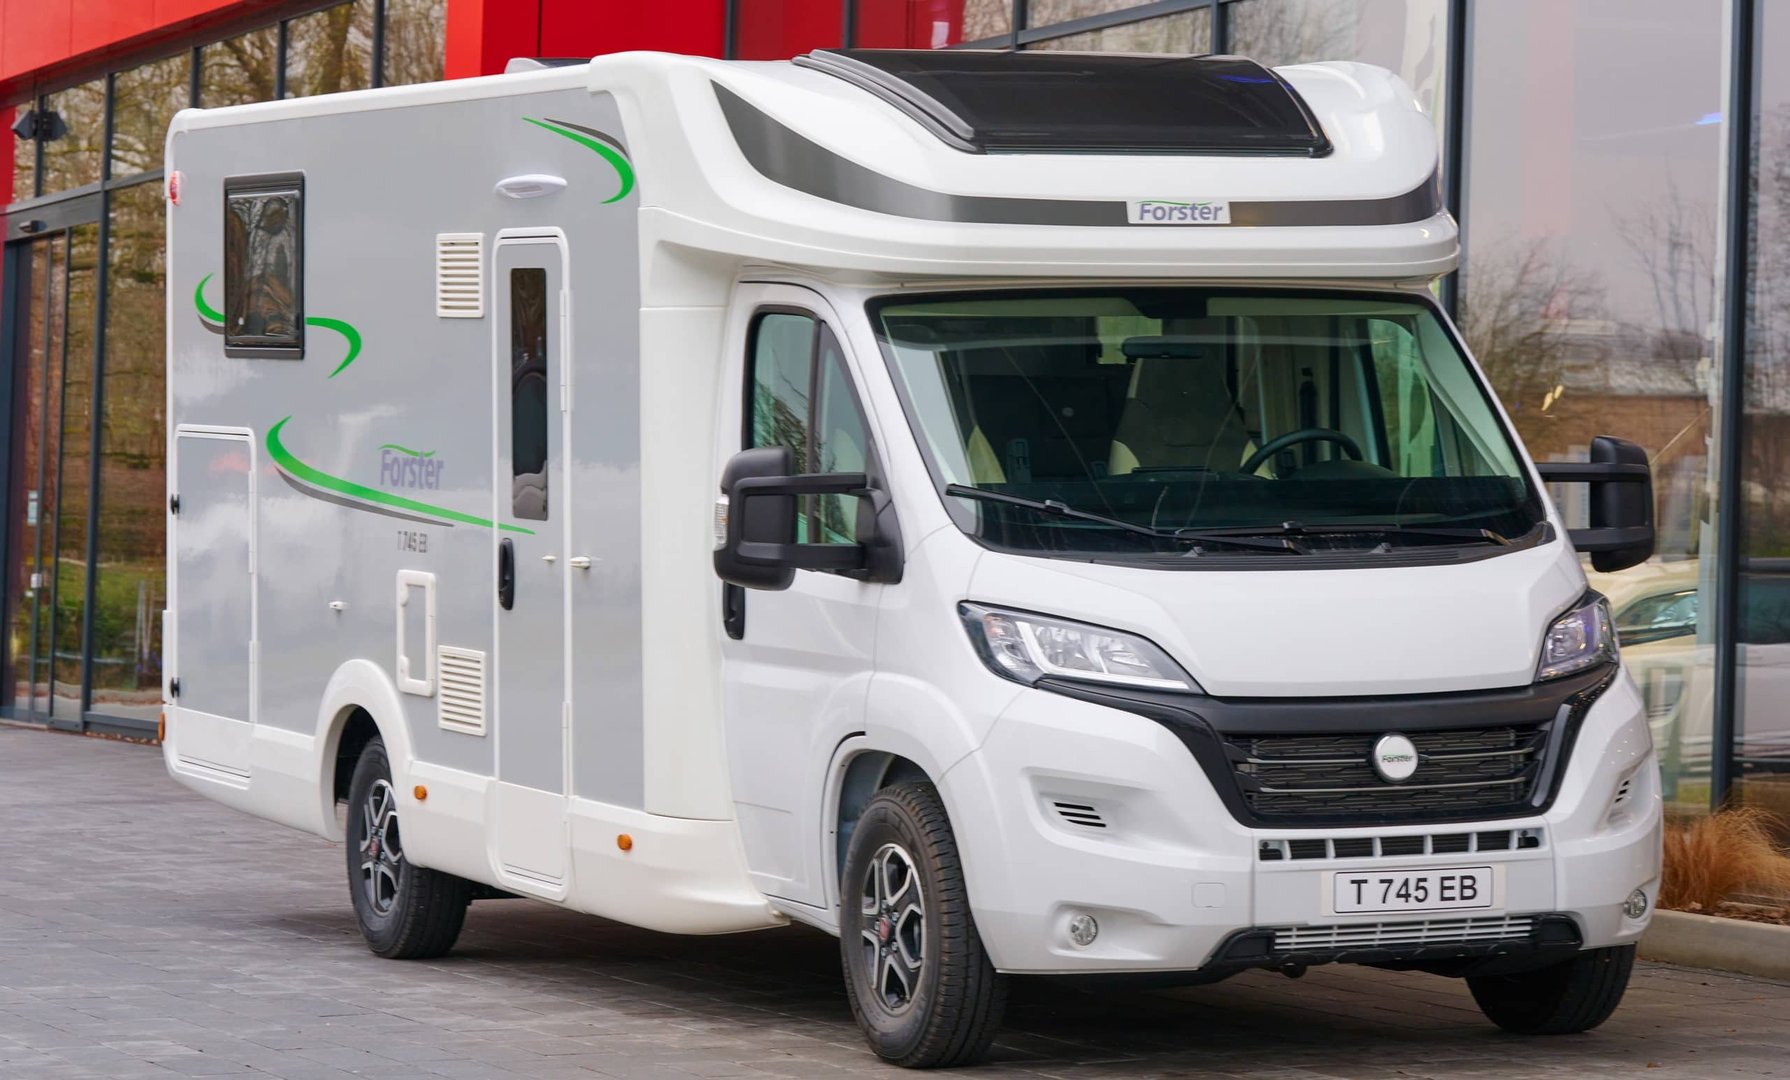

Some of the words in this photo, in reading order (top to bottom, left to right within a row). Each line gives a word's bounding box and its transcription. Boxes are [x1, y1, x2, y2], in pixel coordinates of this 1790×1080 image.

[1139, 202, 1223, 221] Forster
[380, 449, 445, 490] Forster
[1382, 754, 1414, 763] Forster
[1350, 879, 1368, 905] T
[1379, 877, 1428, 904] 745
[1440, 875, 1477, 902] EB
